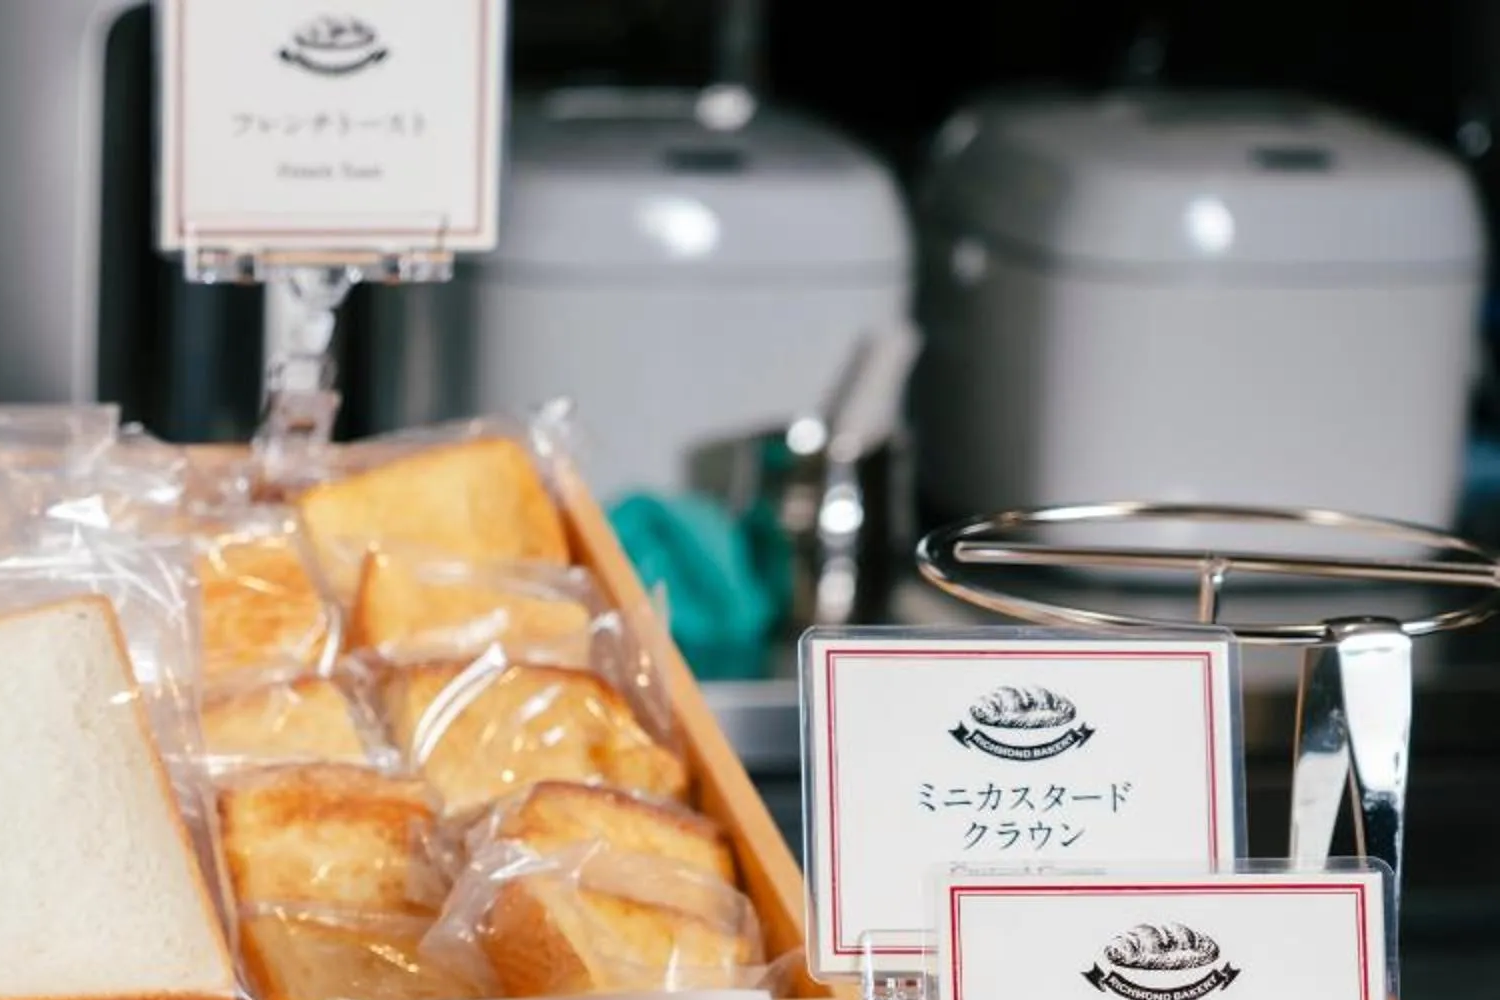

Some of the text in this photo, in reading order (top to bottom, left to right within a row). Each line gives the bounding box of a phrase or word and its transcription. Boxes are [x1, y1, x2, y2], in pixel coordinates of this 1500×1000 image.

[972, 731, 1076, 760] RICHMOND BAKERY
[919, 782, 1132, 813] ミニカスタード
[963, 821, 1085, 850] クラウン
[1172, 975, 1219, 1000] BAKERY
